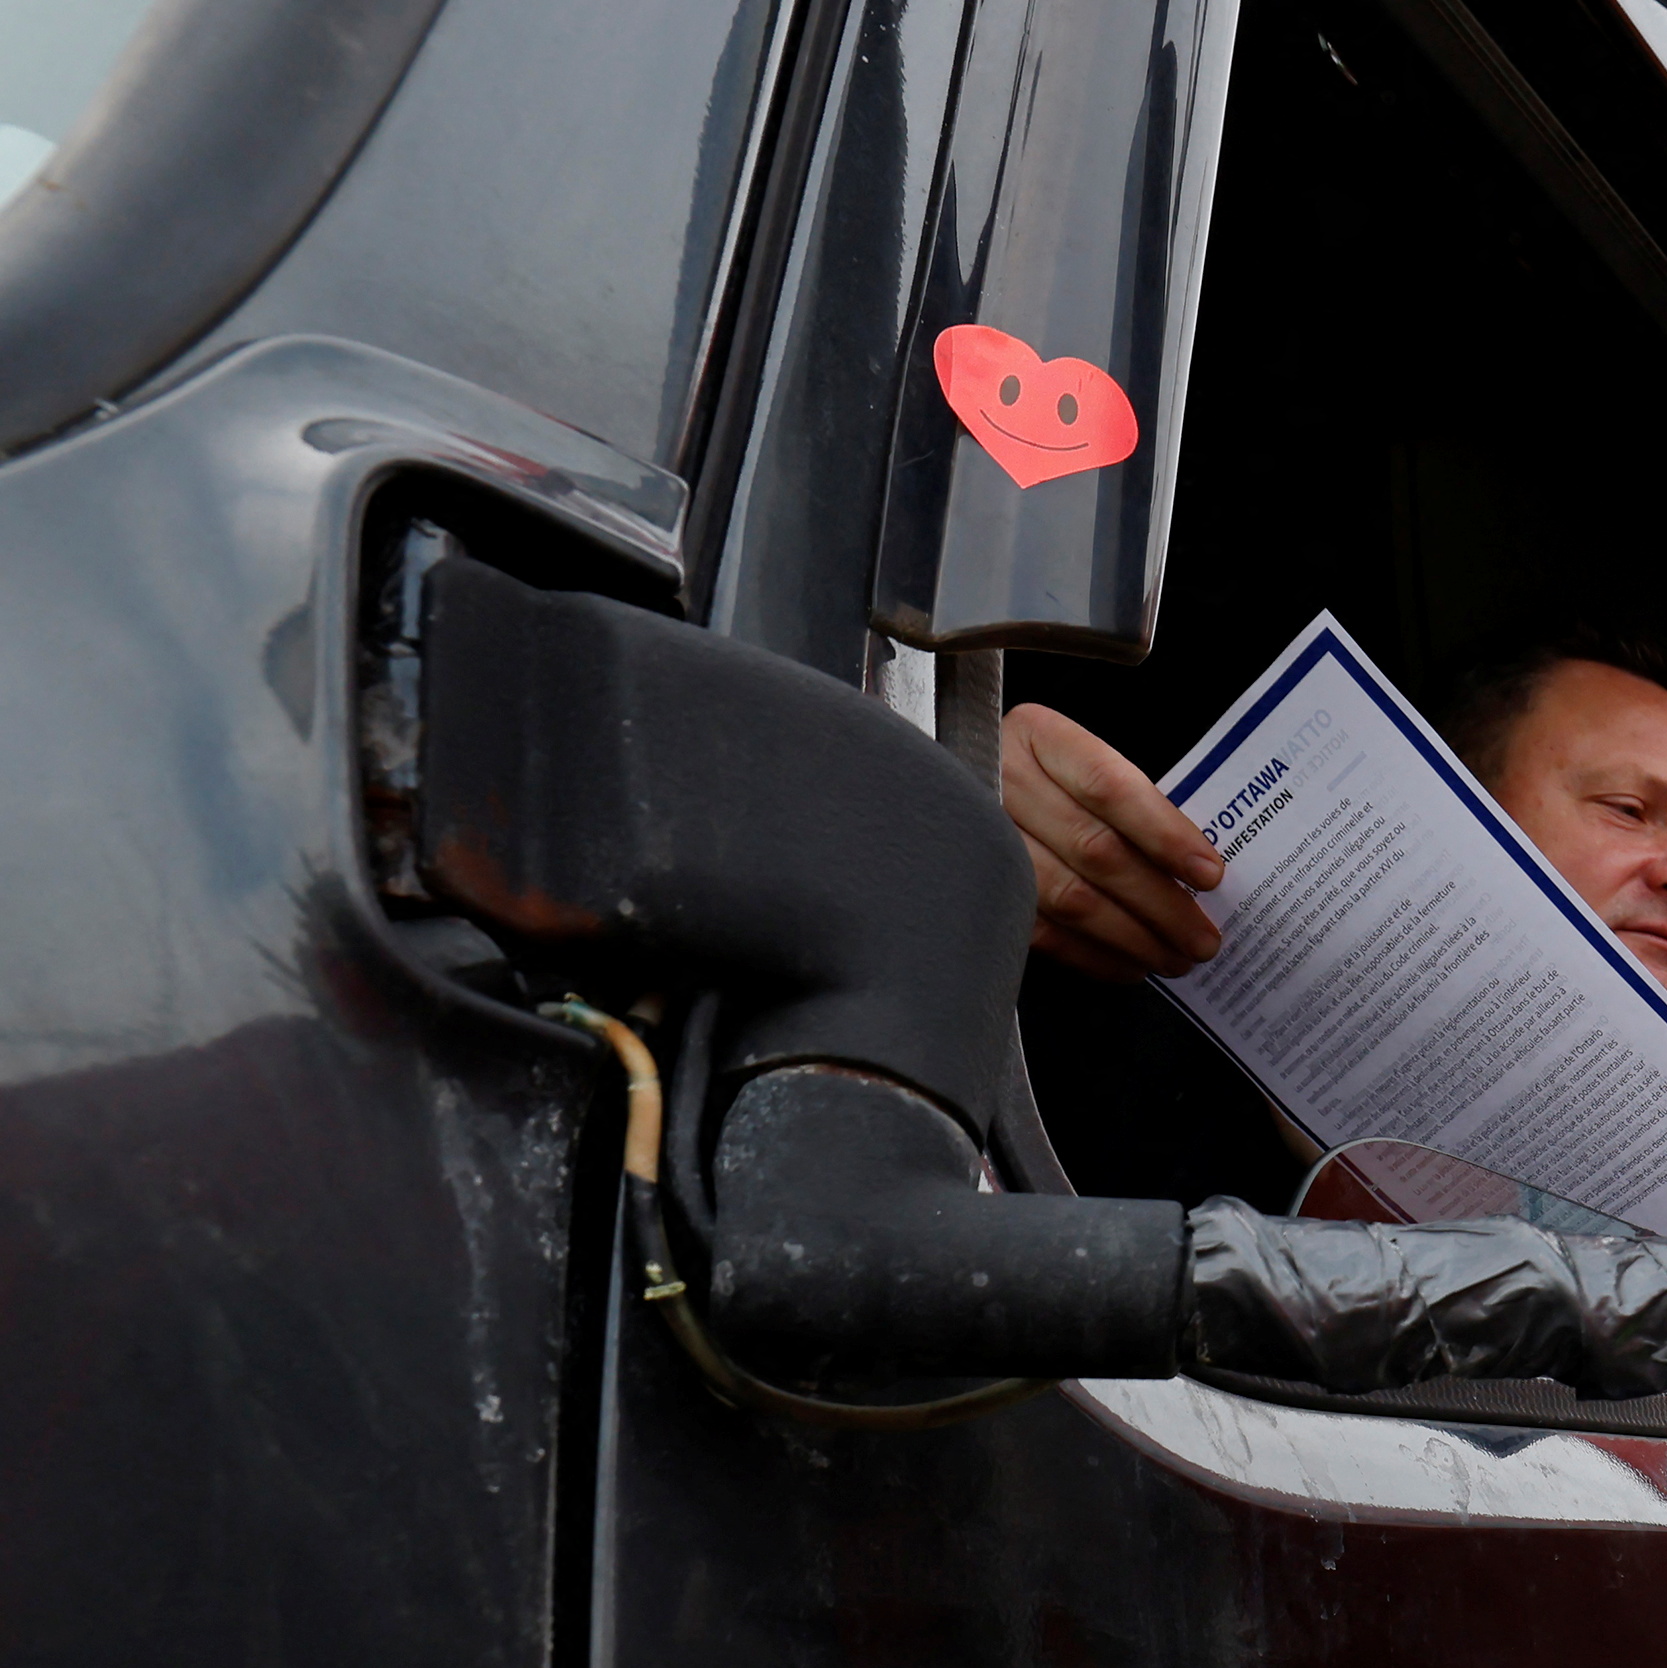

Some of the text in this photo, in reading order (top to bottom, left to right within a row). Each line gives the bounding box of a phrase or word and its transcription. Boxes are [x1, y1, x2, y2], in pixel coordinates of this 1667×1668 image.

[1202, 757, 1289, 846] D'OTTAWA
[1219, 789, 1293, 866] ANIFESTATION
[1239, 798, 1351, 911] Quiconque bloquant les voies de
[1254, 802, 1373, 923] commet une infraction criminelle et
[1302, 817, 1385, 899] vos activités illégales ou
[1318, 822, 1405, 909] arrêté, que vous soyez ou
[1333, 850, 1404, 919] dans la partie XVI du
